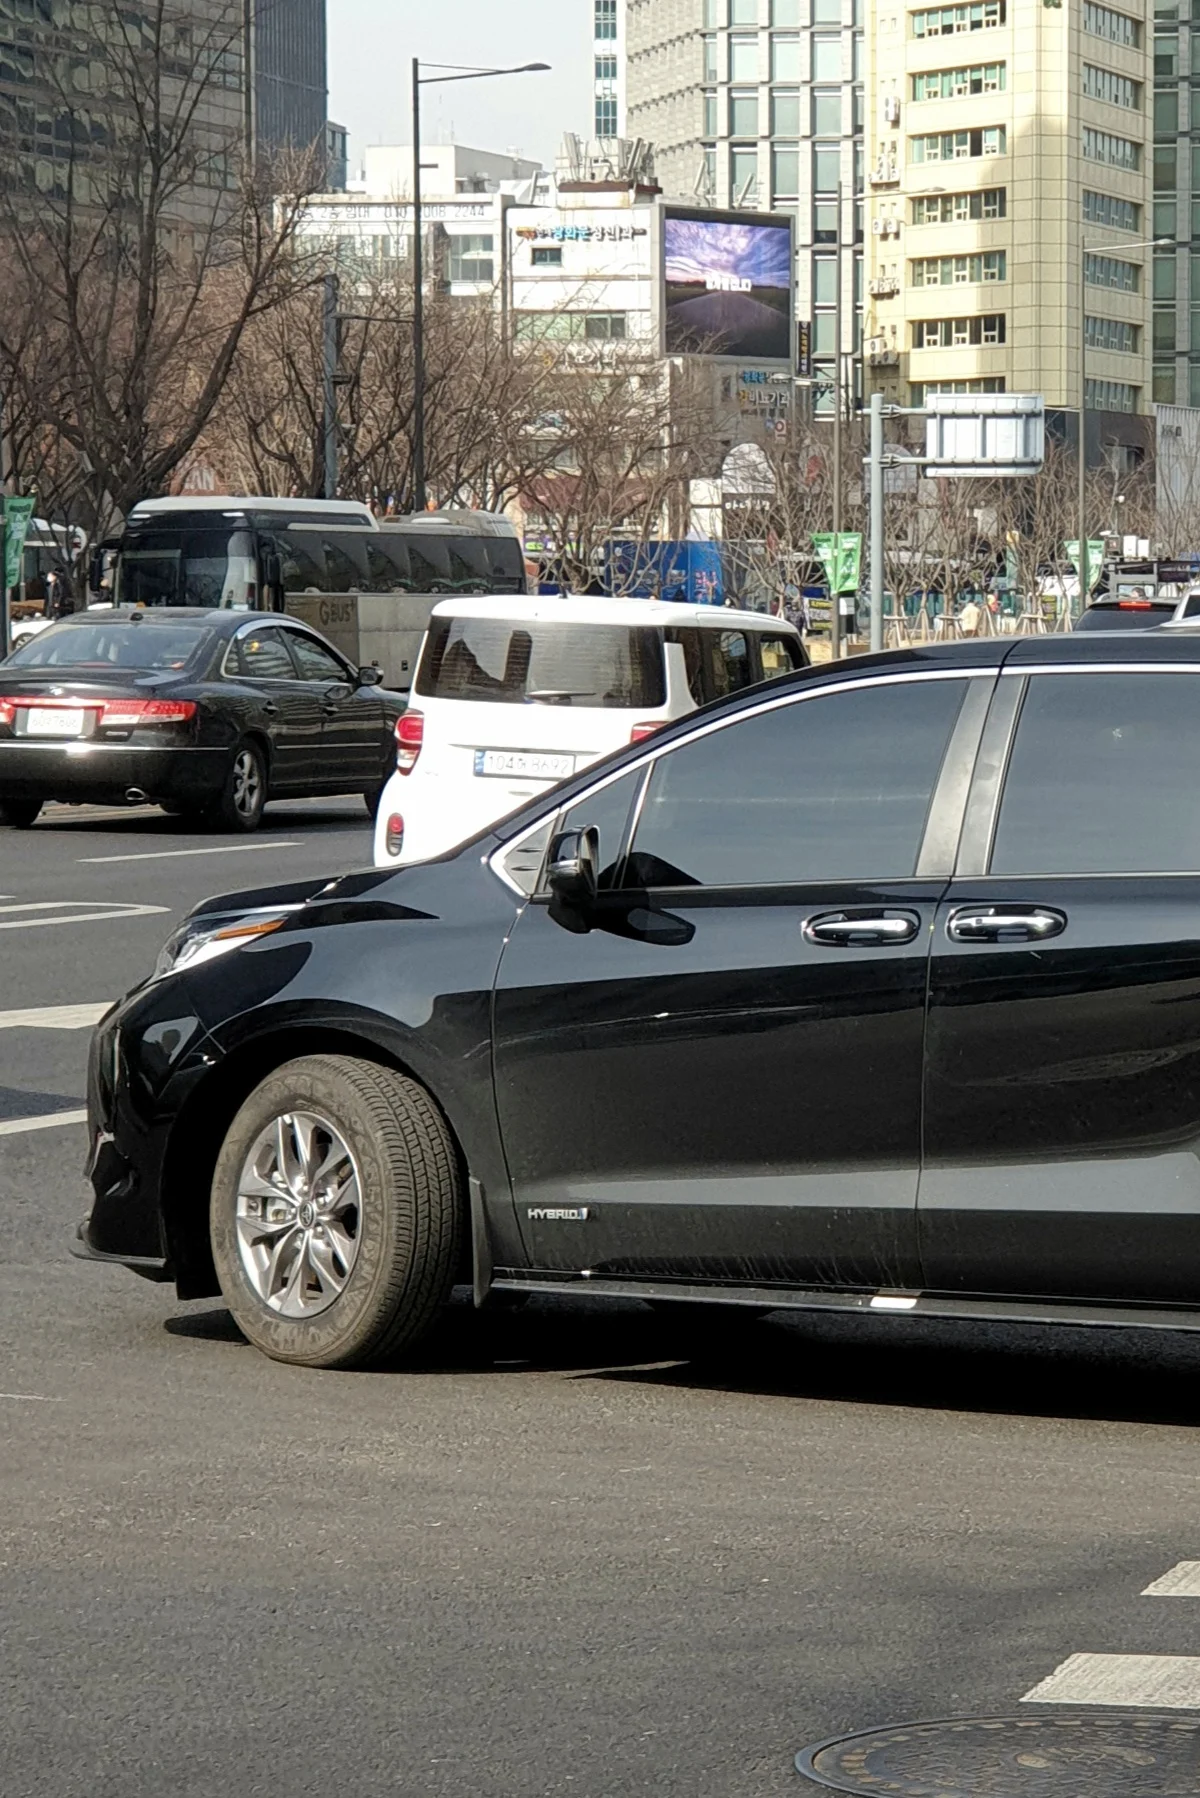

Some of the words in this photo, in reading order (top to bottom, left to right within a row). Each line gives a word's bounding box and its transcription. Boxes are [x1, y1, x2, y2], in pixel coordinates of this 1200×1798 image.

[346, 205, 370, 220] 임대
[454, 204, 485, 217] 2244
[527, 1208, 579, 1220] HYBRID
